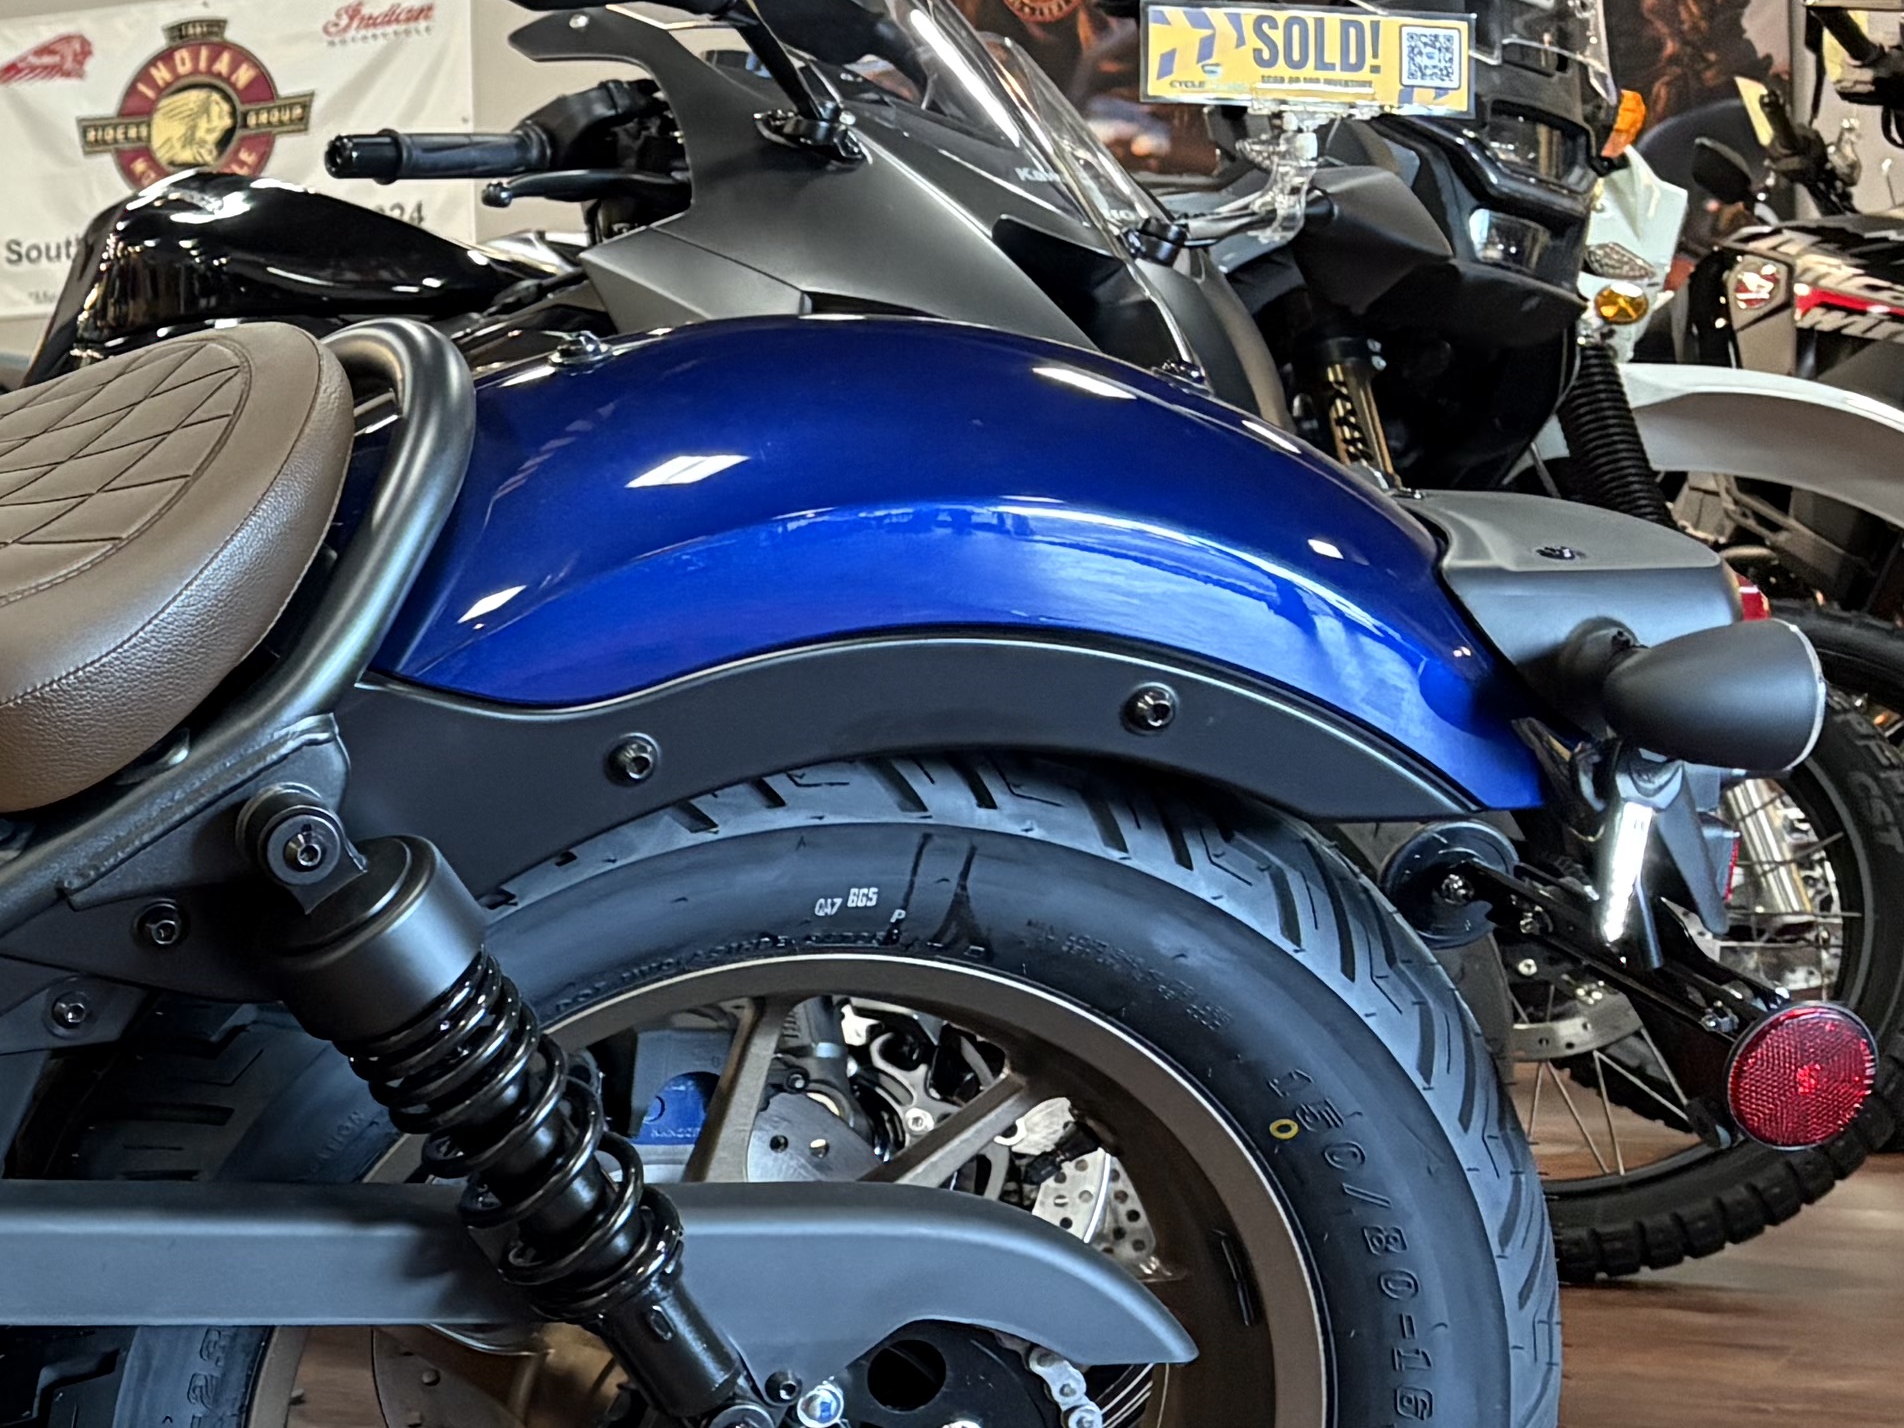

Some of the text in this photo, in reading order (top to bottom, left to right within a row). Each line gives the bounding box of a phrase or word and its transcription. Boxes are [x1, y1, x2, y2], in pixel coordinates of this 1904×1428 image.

[322, 0, 434, 38] Indian
[1253, 15, 1381, 74] SOLD!
[137, 45, 257, 100] INDIAN
[5, 236, 82, 265] Sout
